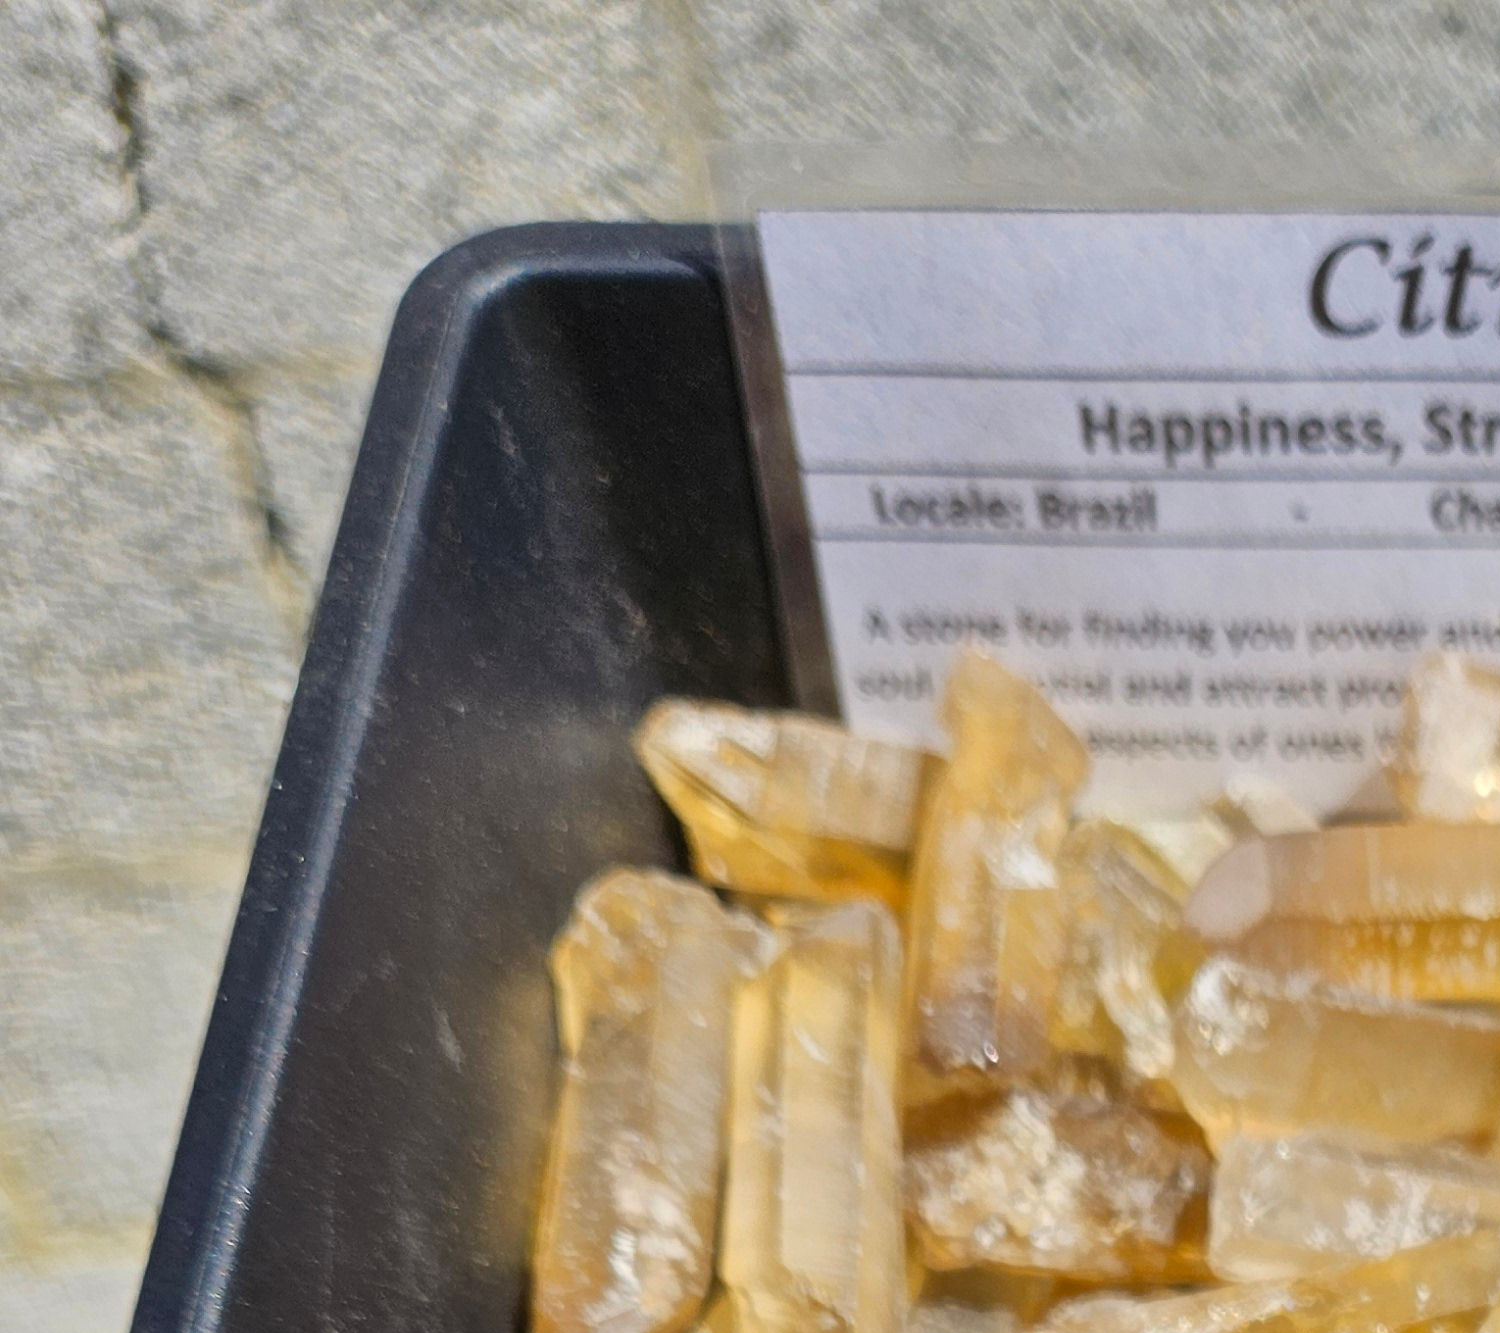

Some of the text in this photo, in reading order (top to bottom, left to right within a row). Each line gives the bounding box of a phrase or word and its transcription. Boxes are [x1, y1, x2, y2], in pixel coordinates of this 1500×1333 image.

[1078, 401, 1402, 466] Happiness,
[870, 487, 1158, 532] Locale: Brazil
[864, 606, 892, 641] A
[1016, 606, 1072, 644] for
[1083, 607, 1216, 656] finding
[1226, 617, 1296, 659] you
[1306, 617, 1427, 659] power
[1122, 669, 1194, 708] and
